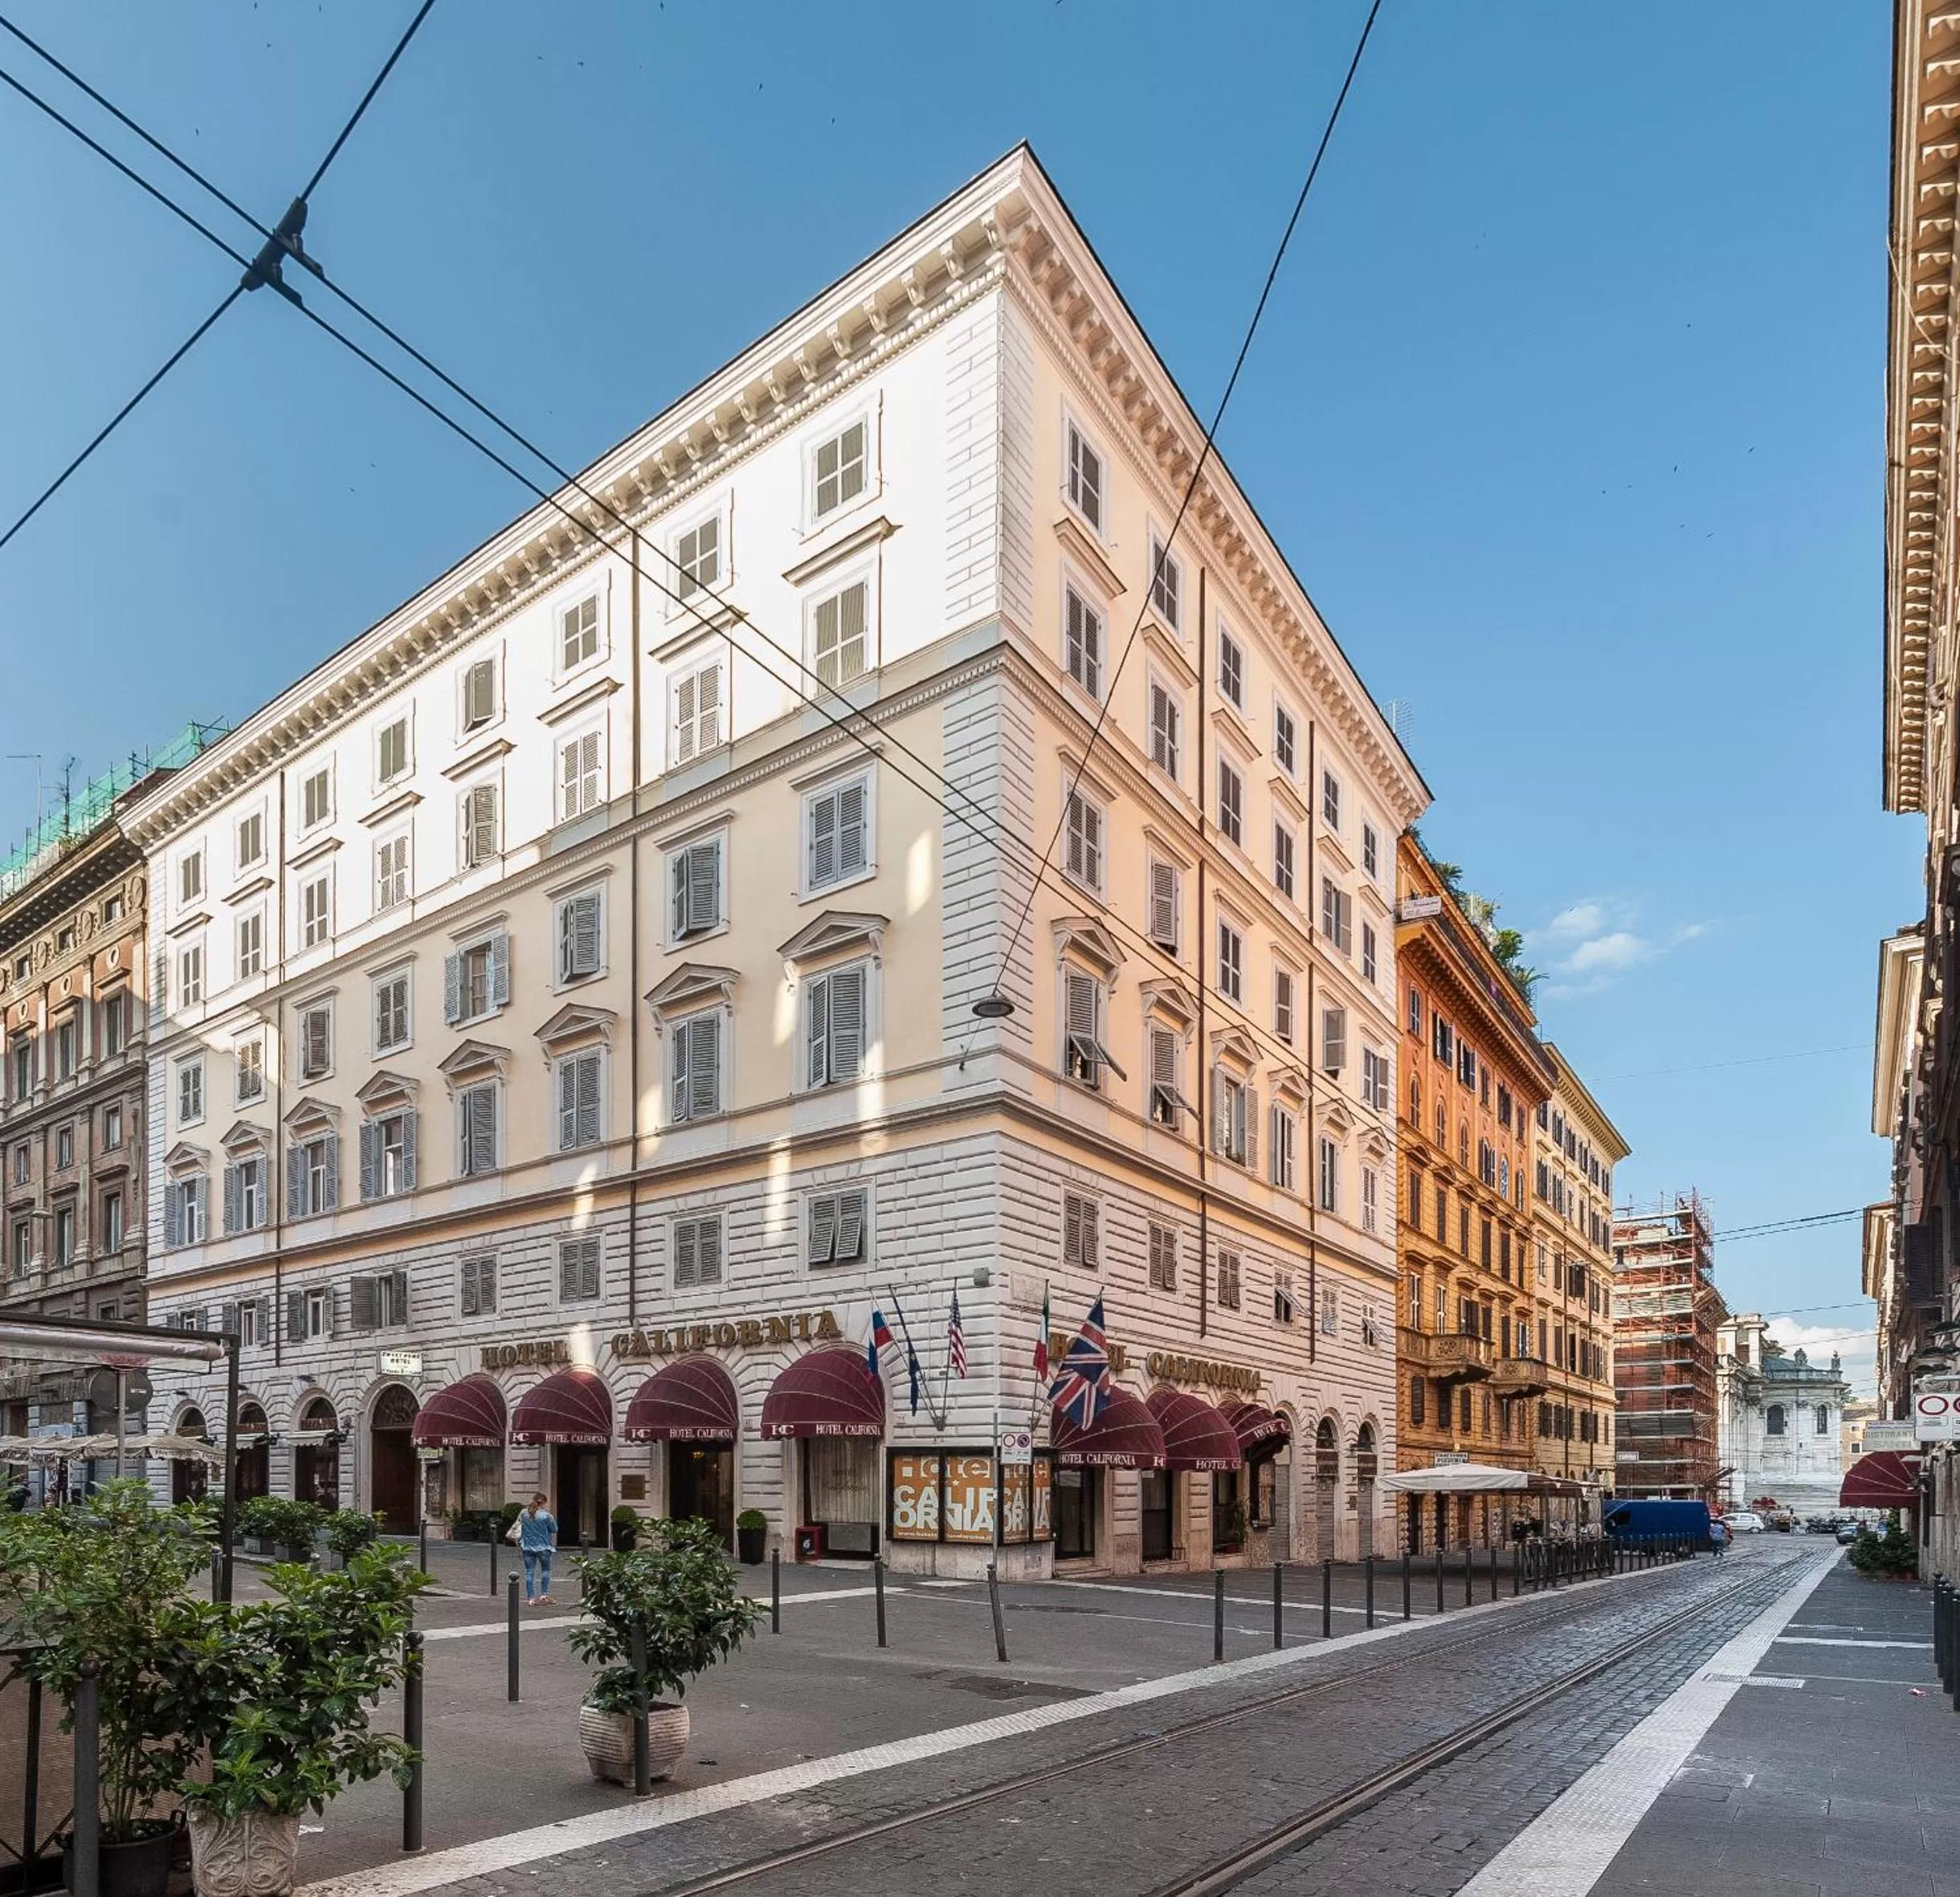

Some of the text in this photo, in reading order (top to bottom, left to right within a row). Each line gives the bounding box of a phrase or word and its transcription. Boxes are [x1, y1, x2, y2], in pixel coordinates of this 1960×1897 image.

[480, 1310, 842, 1369] HOTEL CALIFORNIA
[1146, 1352, 1261, 1391] CALIFORNIA
[669, 1429, 733, 1438] HOTEL CALIFORNIA
[816, 1425, 880, 1436] HOTEL CALIFORNIA
[443, 1437, 464, 1446] HOTEL
[545, 1434, 607, 1445] HOTEL CALIFORNIA
[1060, 1454, 1137, 1466] HOTEL CALIFORNIA
[1196, 1460, 1227, 1470] HOTEL
